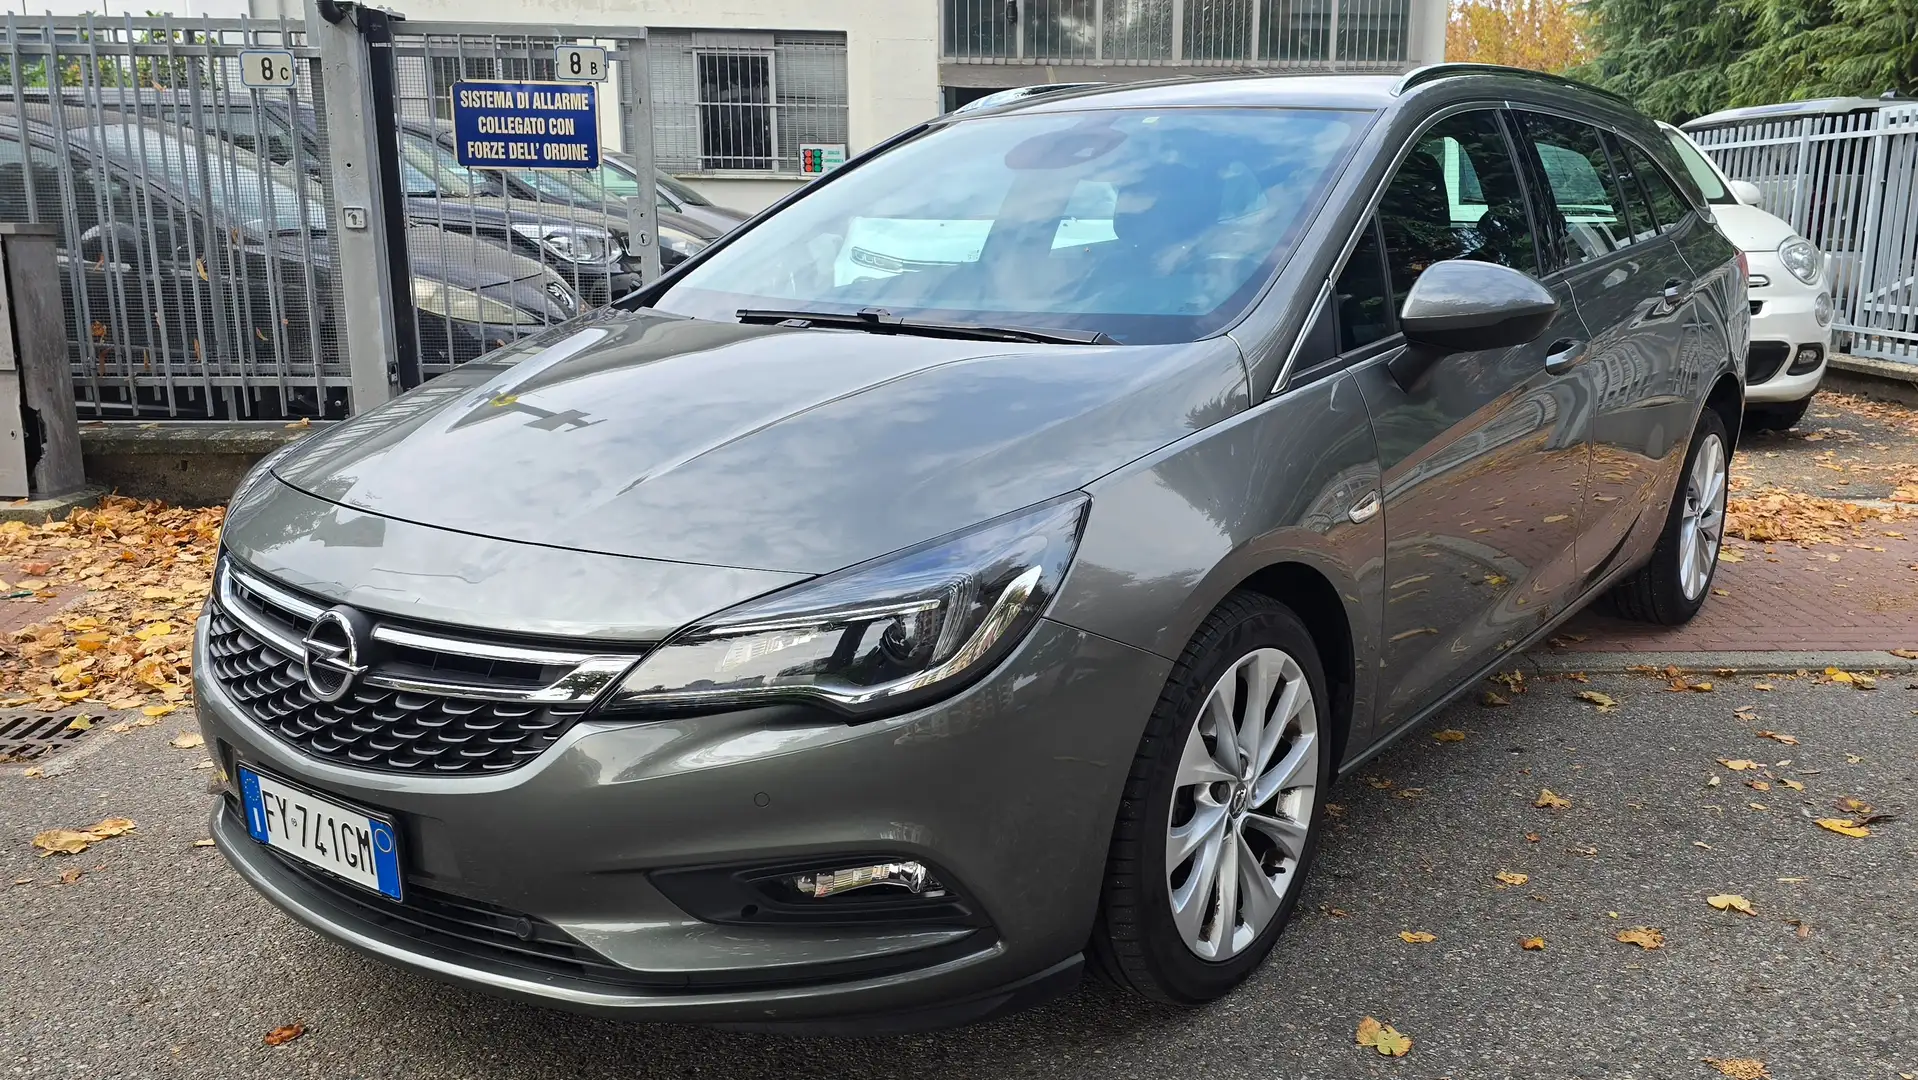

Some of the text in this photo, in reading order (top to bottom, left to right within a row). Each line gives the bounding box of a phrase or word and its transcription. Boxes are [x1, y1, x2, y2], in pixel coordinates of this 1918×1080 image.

[261, 56, 289, 81] 8 C
[569, 51, 598, 75] 8 B
[460, 90, 589, 111] SISTEMA DI ALLARME
[478, 116, 575, 136] COLLEGATO CON
[467, 141, 589, 161] FORZE DELL' ORDINE
